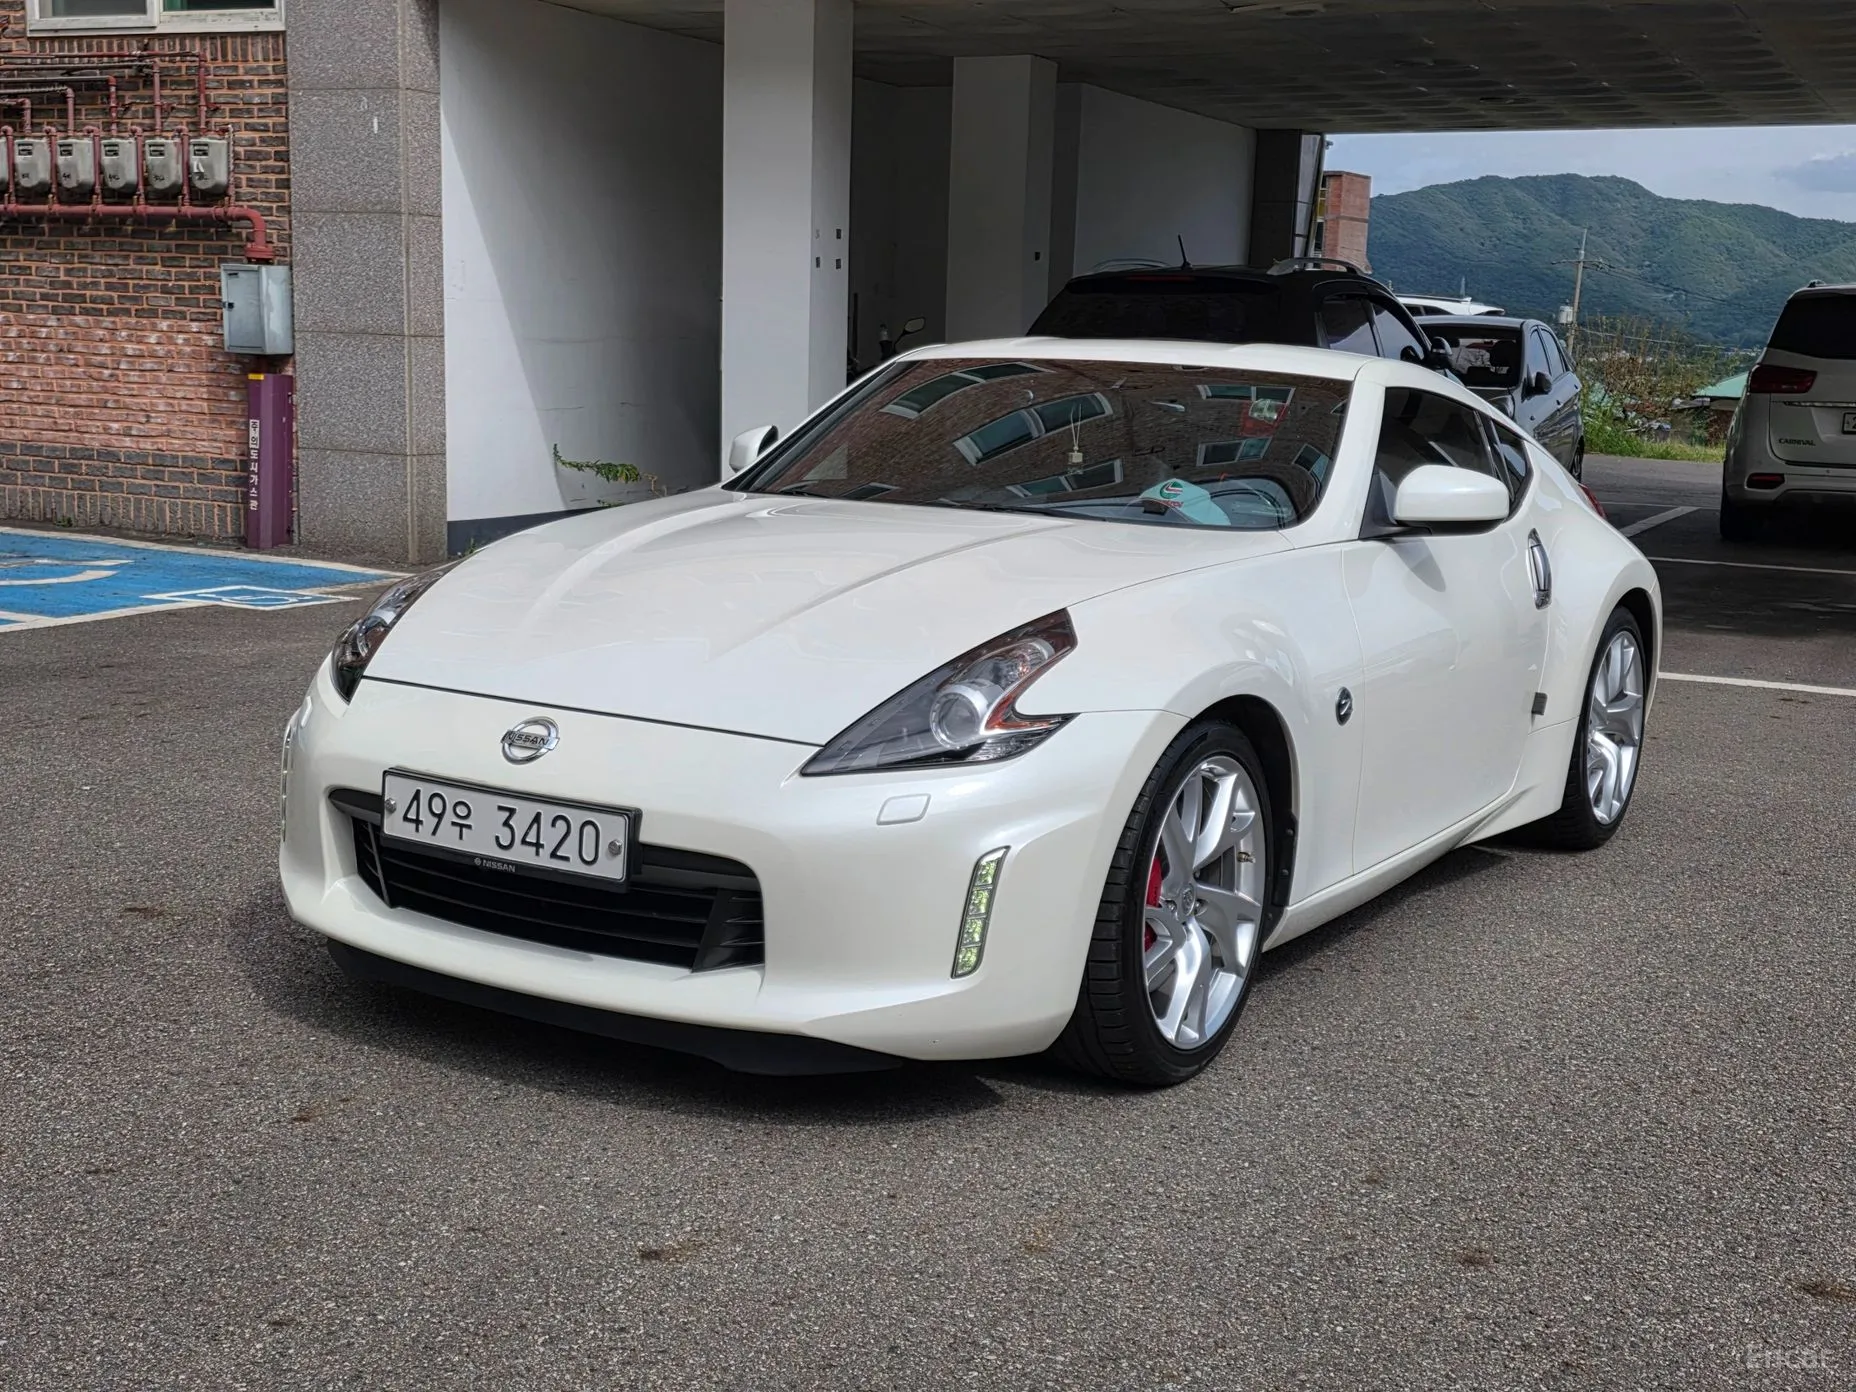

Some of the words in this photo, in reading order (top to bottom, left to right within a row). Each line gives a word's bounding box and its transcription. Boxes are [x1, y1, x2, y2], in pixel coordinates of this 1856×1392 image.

[506, 730, 549, 746] NISSAN
[402, 788, 473, 841] 49우
[494, 804, 601, 866] 3420
[482, 858, 516, 873] NISSAN
